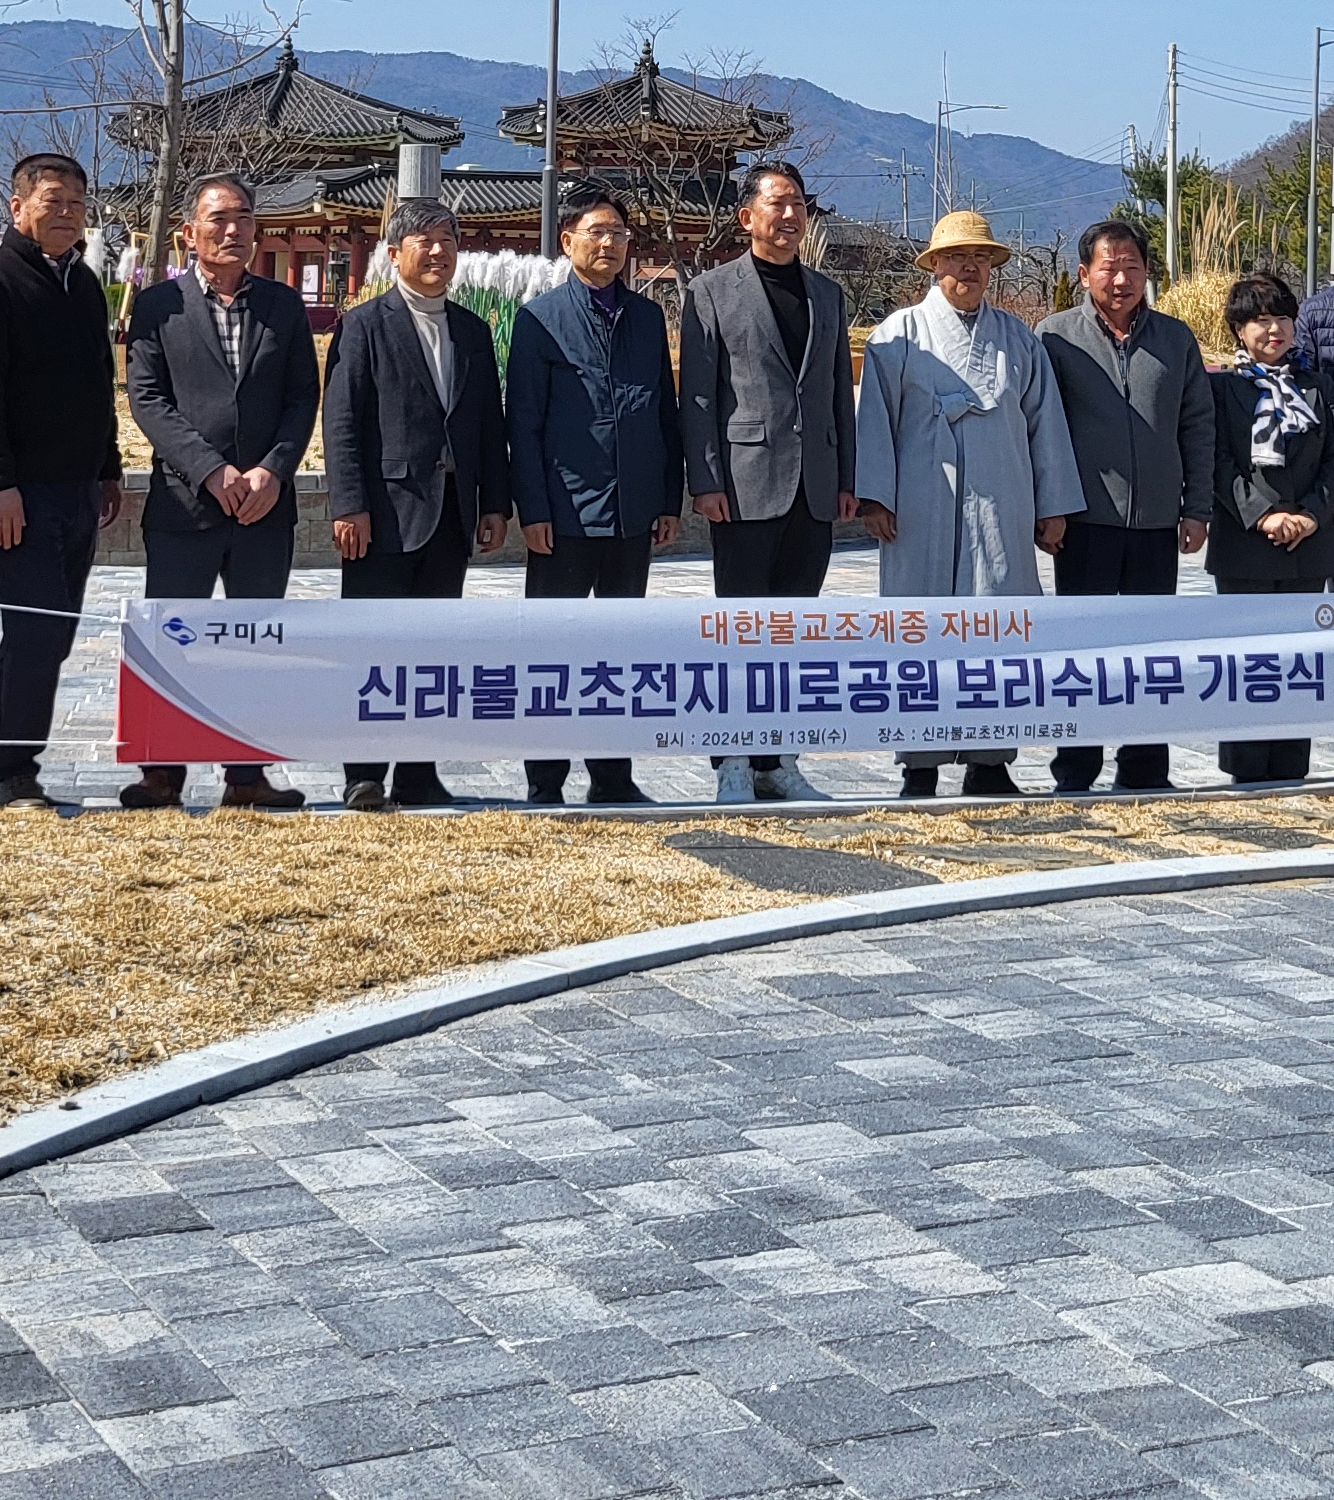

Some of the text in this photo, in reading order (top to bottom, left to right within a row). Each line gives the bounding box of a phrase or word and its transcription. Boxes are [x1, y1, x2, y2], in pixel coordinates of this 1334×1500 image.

[204, 622, 283, 644] 구미시
[700, 609, 1033, 645] 대한불교조계종 자비사
[358, 652, 1325, 721] 신라불교초전지 미로공원 보리수나무 기증식
[655, 731, 684, 747] 일시
[701, 730, 754, 746] 2024년
[759, 729, 783, 746] 3월
[788, 727, 848, 745] 13일(수)
[877, 726, 906, 743] 장소
[921, 723, 1019, 742] 신라불교초전지
[1023, 722, 1078, 740] 미로공원
